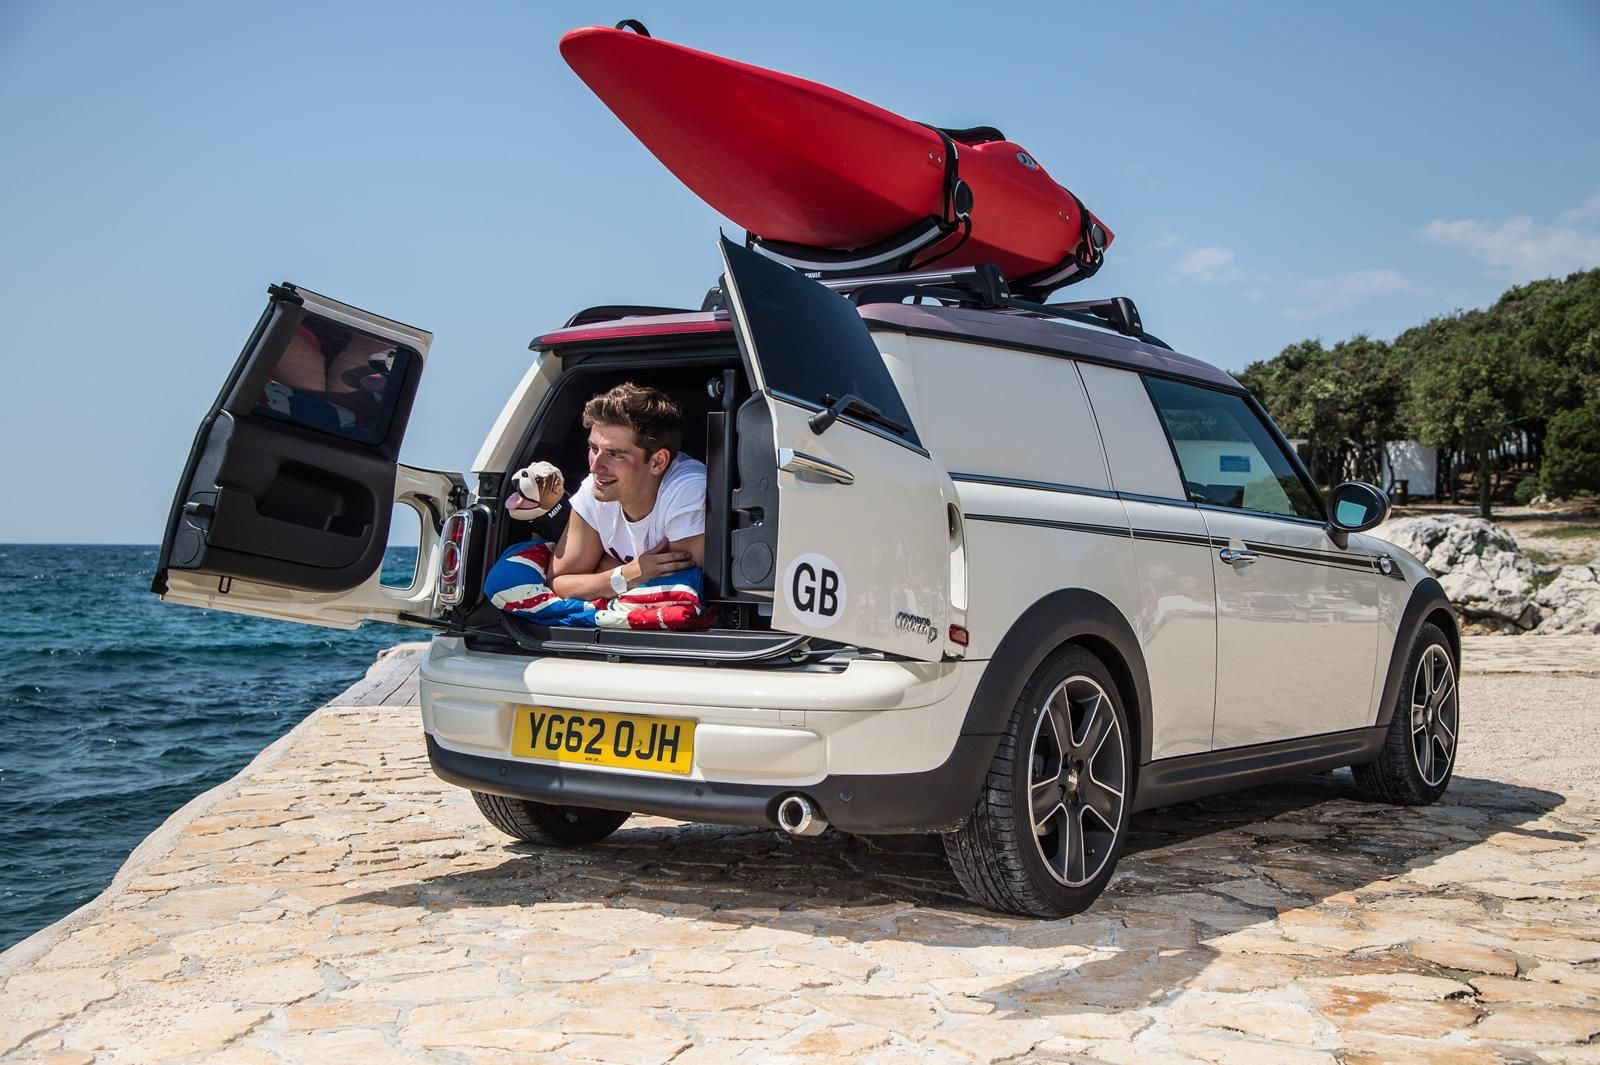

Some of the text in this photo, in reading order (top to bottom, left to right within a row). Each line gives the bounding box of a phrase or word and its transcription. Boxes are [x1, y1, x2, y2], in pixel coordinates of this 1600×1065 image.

[548, 503, 562, 518] MINI
[792, 562, 839, 617] GB
[529, 712, 681, 763] YG62 OJH
